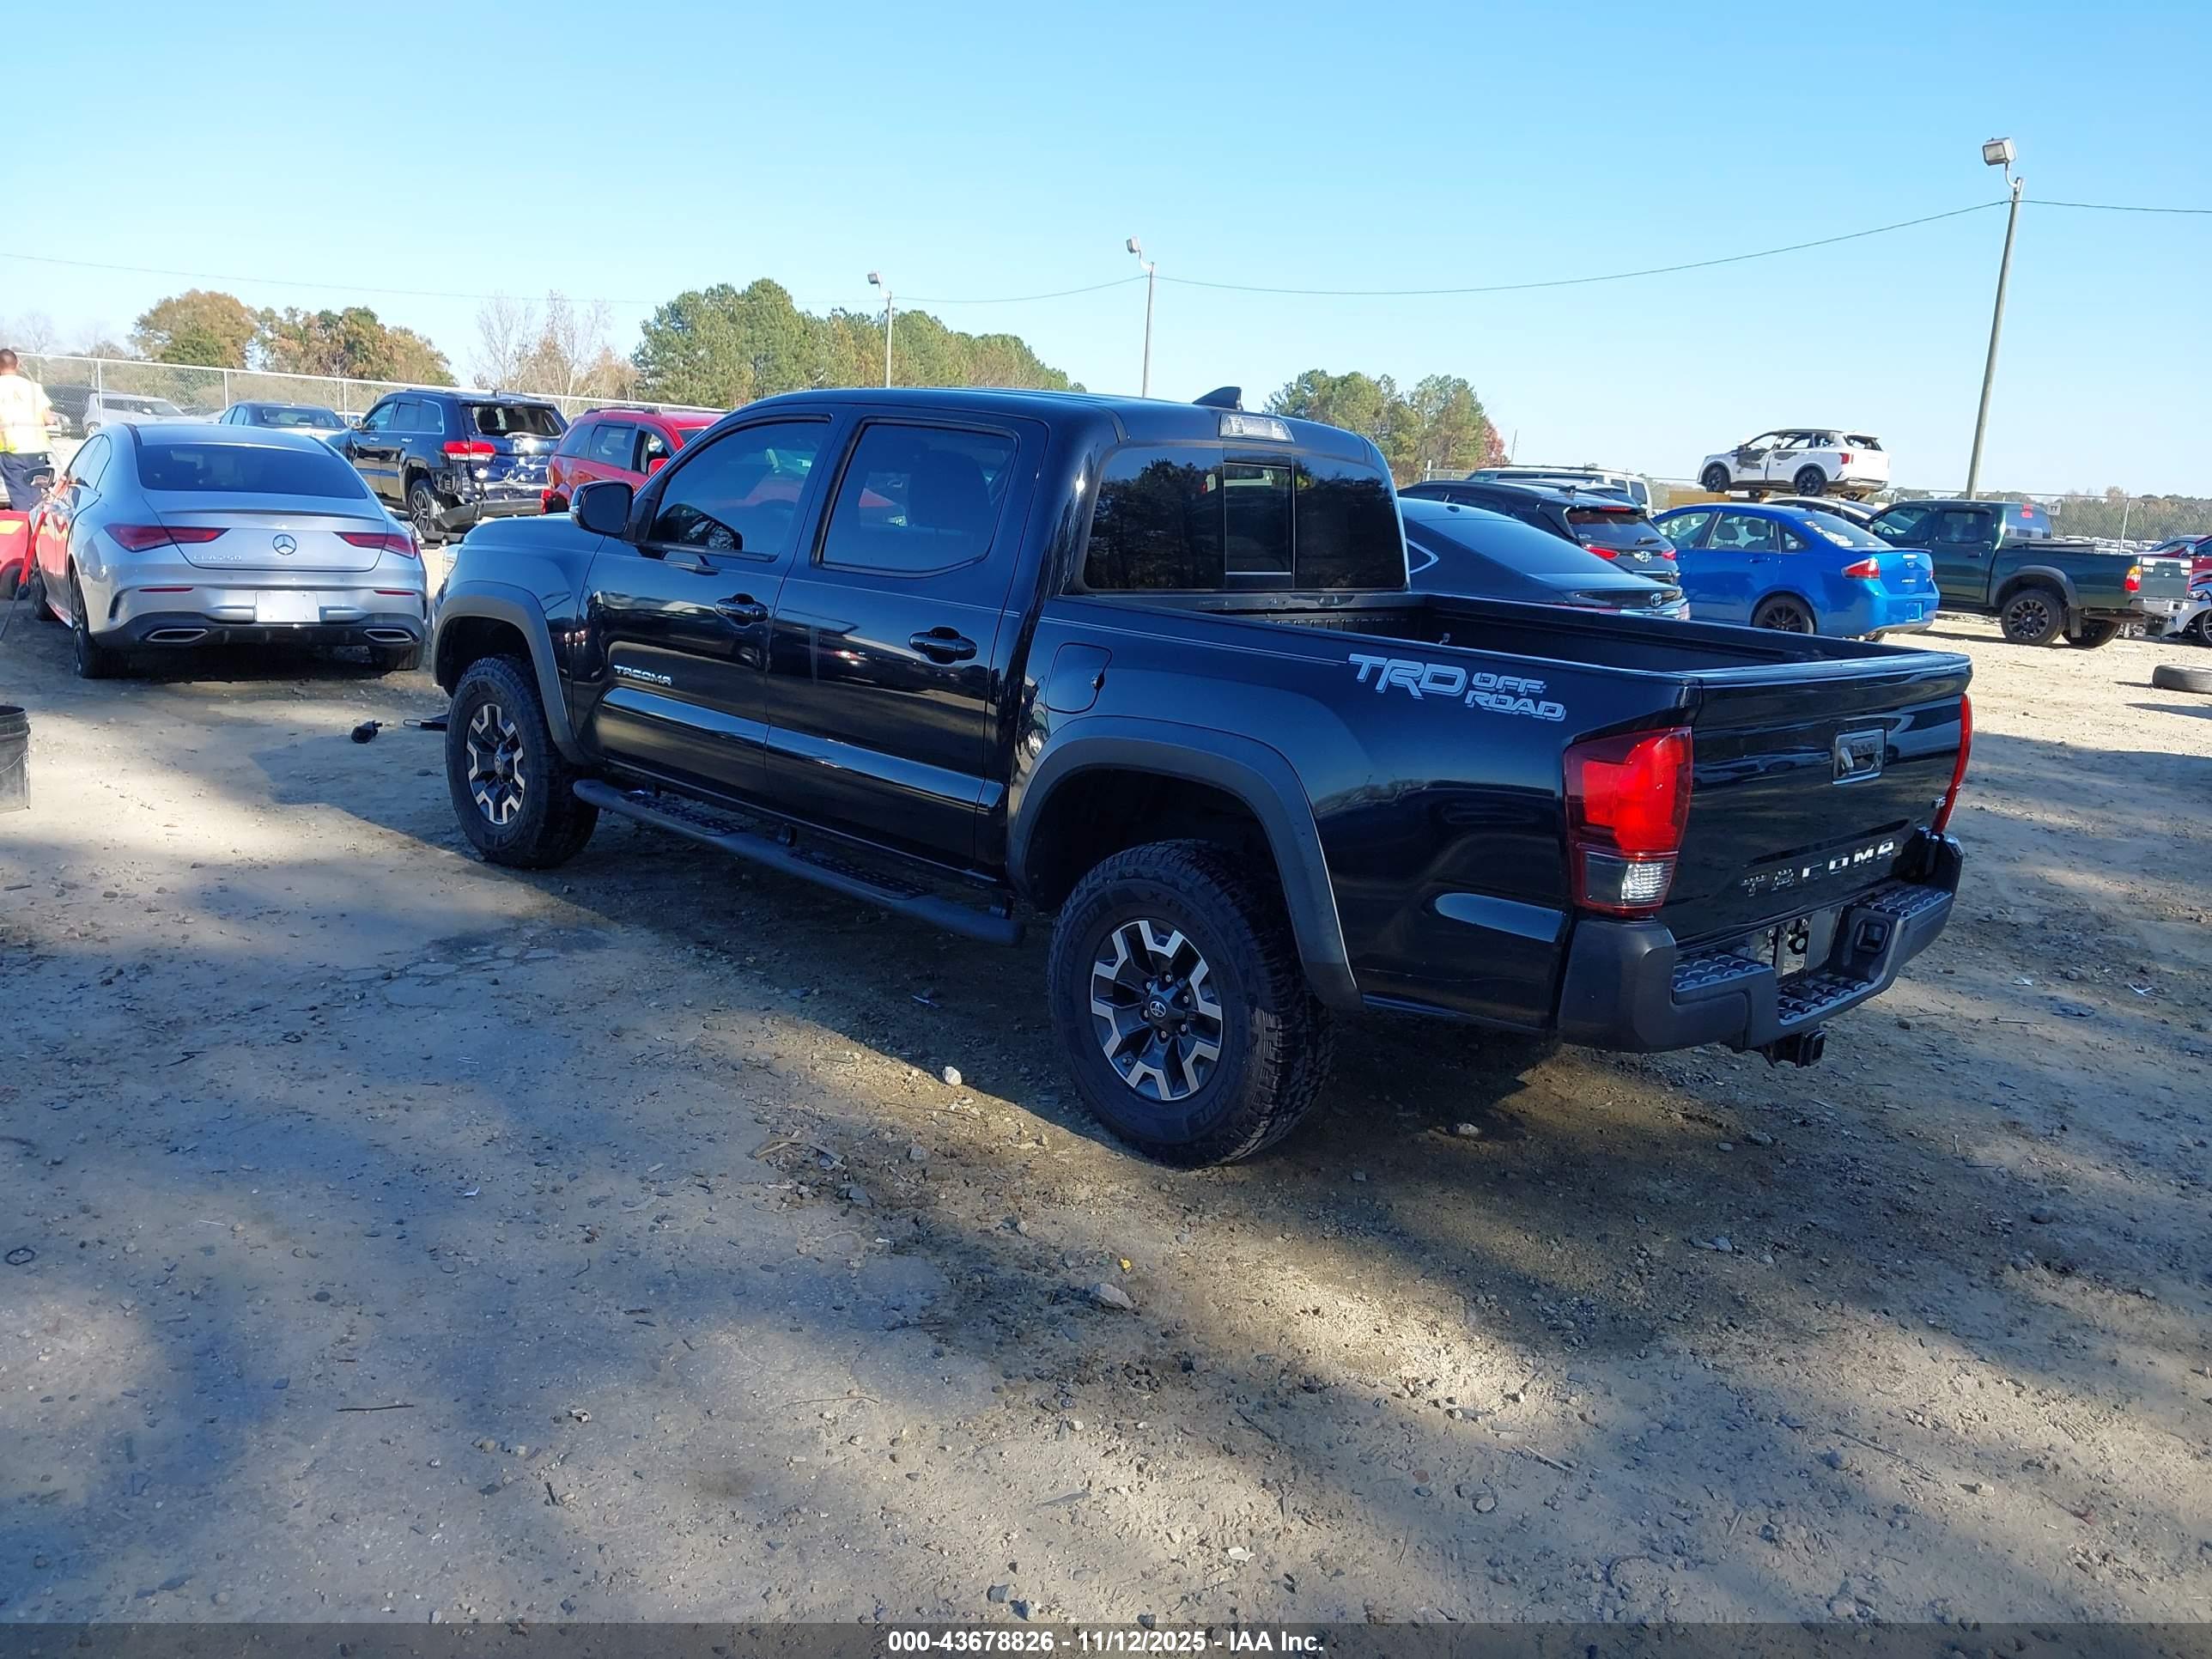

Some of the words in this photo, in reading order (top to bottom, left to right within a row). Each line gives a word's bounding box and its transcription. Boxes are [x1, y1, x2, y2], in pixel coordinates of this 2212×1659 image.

[614, 665, 672, 686] TACOMA
[1347, 653, 1470, 700] TRD
[1471, 672, 1547, 696] OFF
[1464, 690, 1567, 722] ROAD
[1740, 838, 1895, 897] TACOMA
